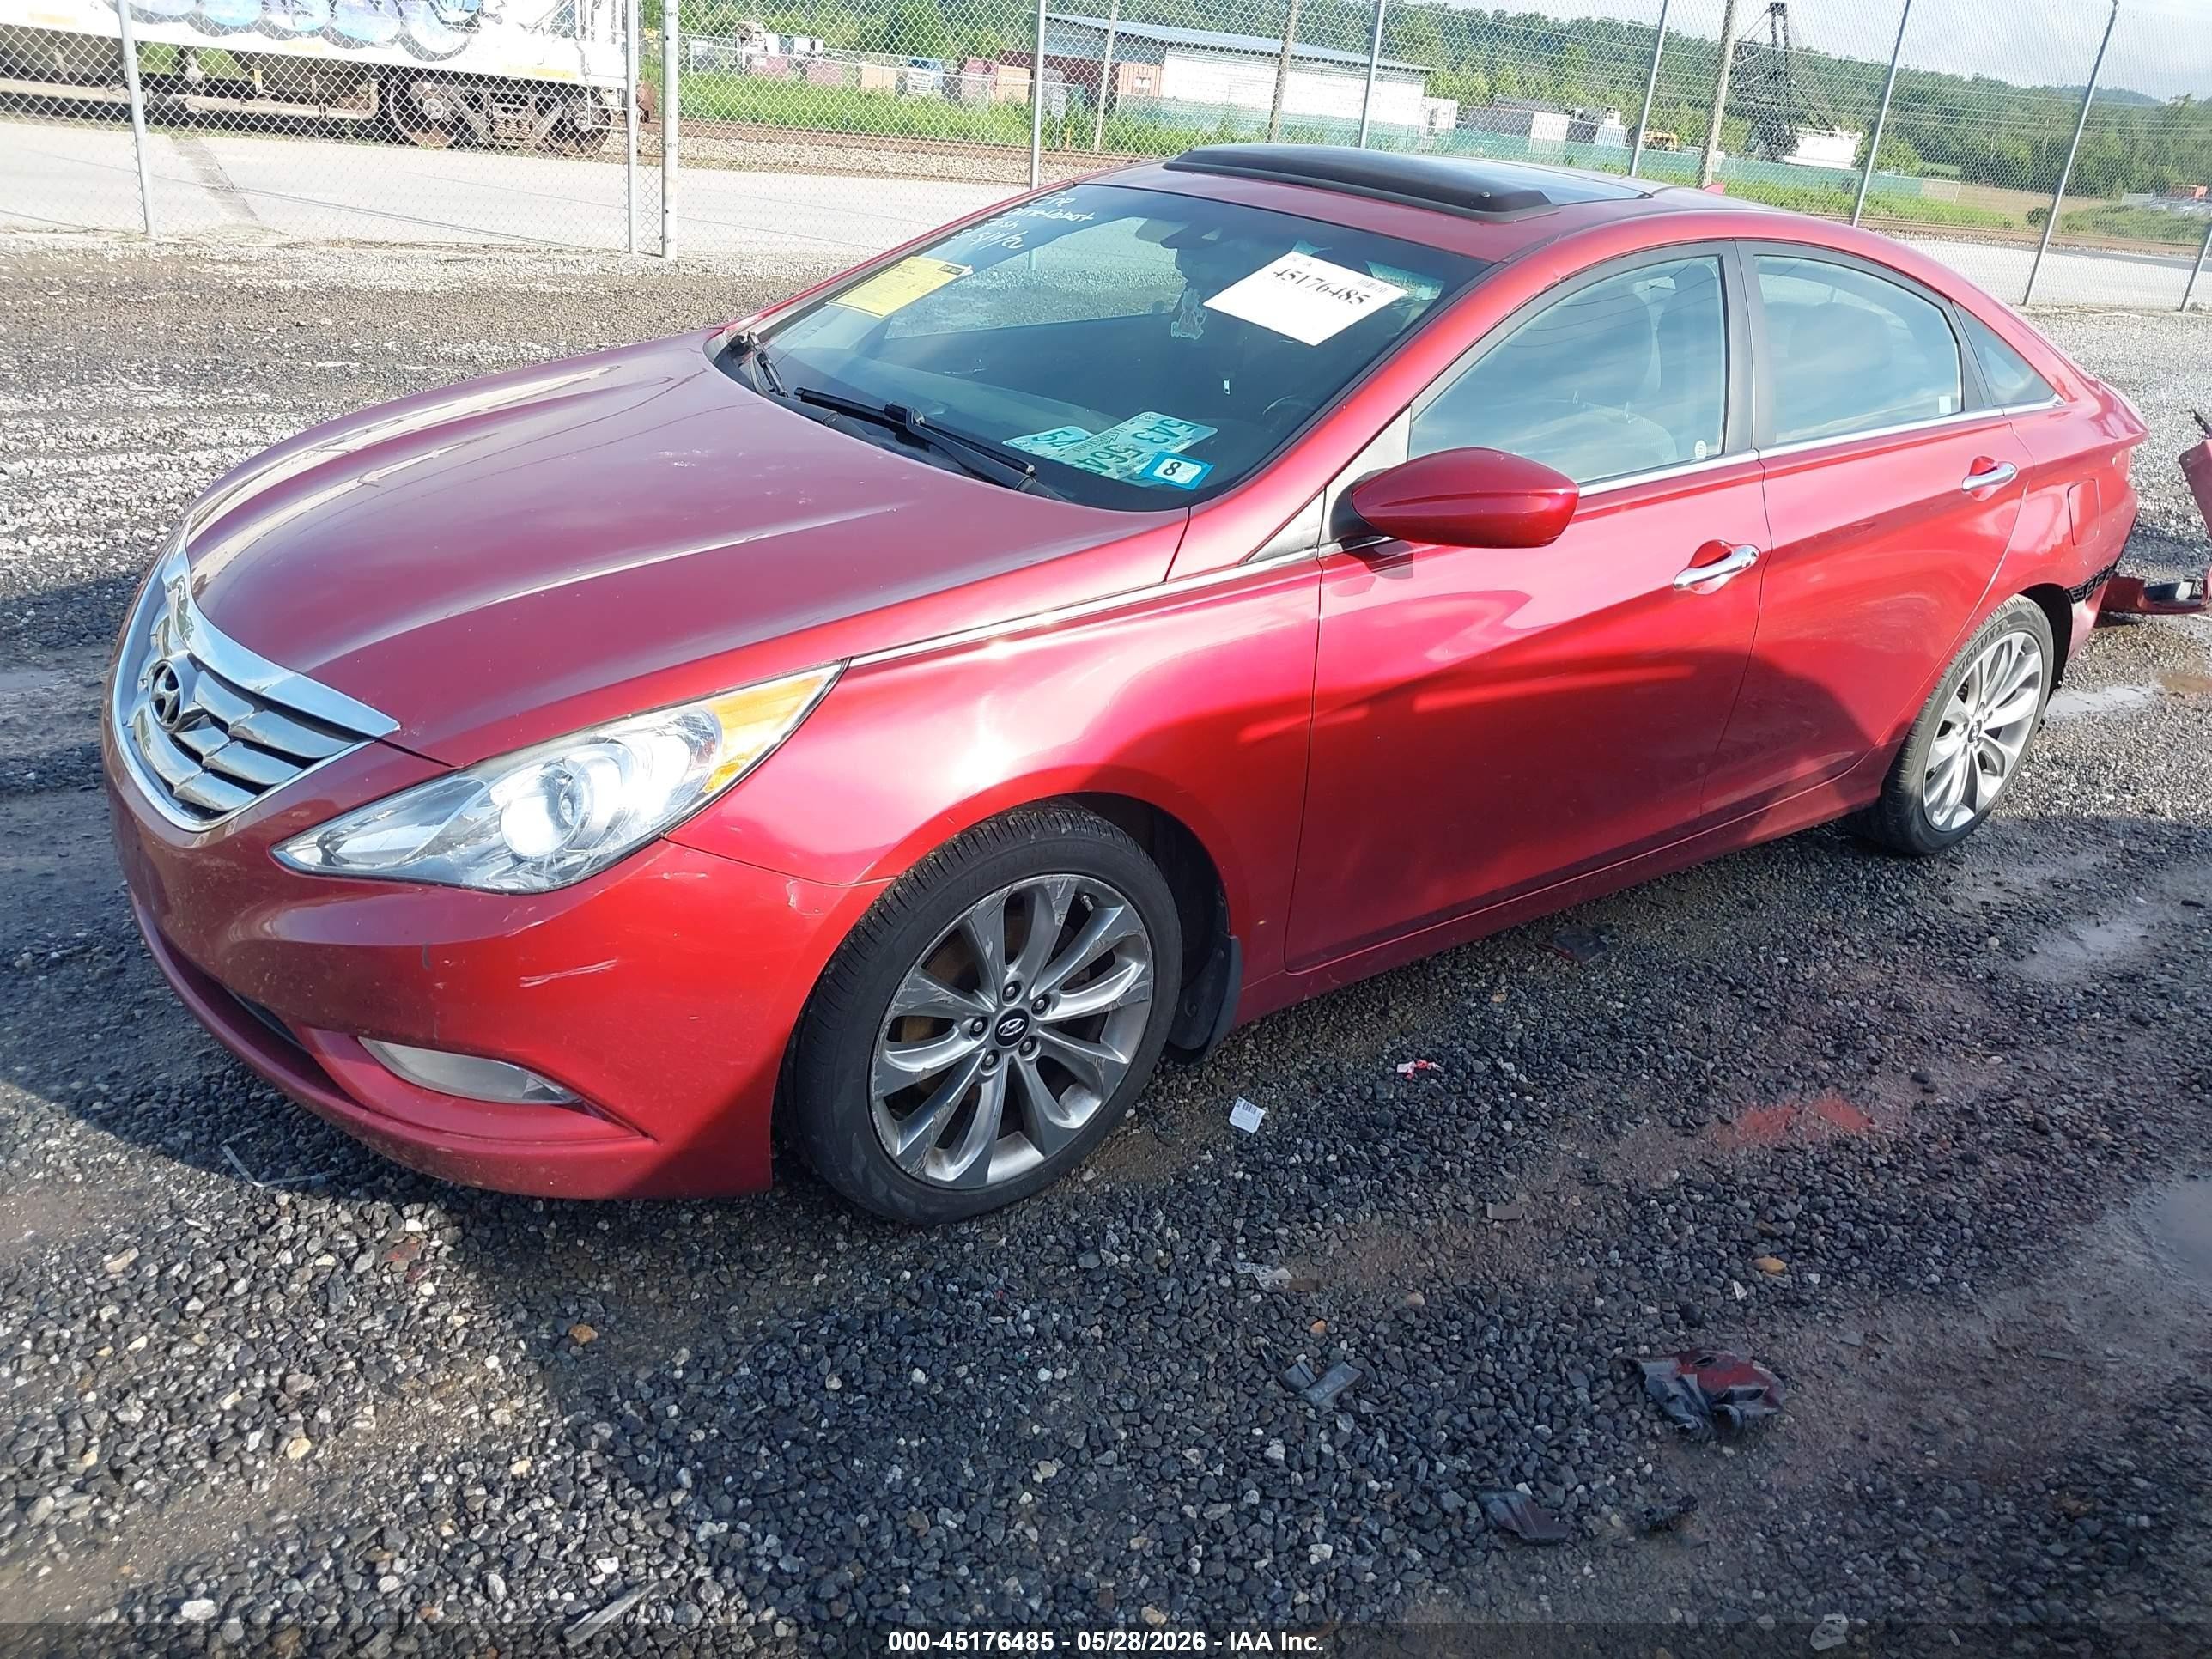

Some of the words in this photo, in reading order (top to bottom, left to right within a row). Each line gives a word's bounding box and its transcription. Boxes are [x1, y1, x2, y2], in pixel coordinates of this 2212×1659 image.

[1273, 268, 1371, 305] 45176485
[1131, 418, 1199, 445] 543
[1163, 461, 1182, 476] 8
